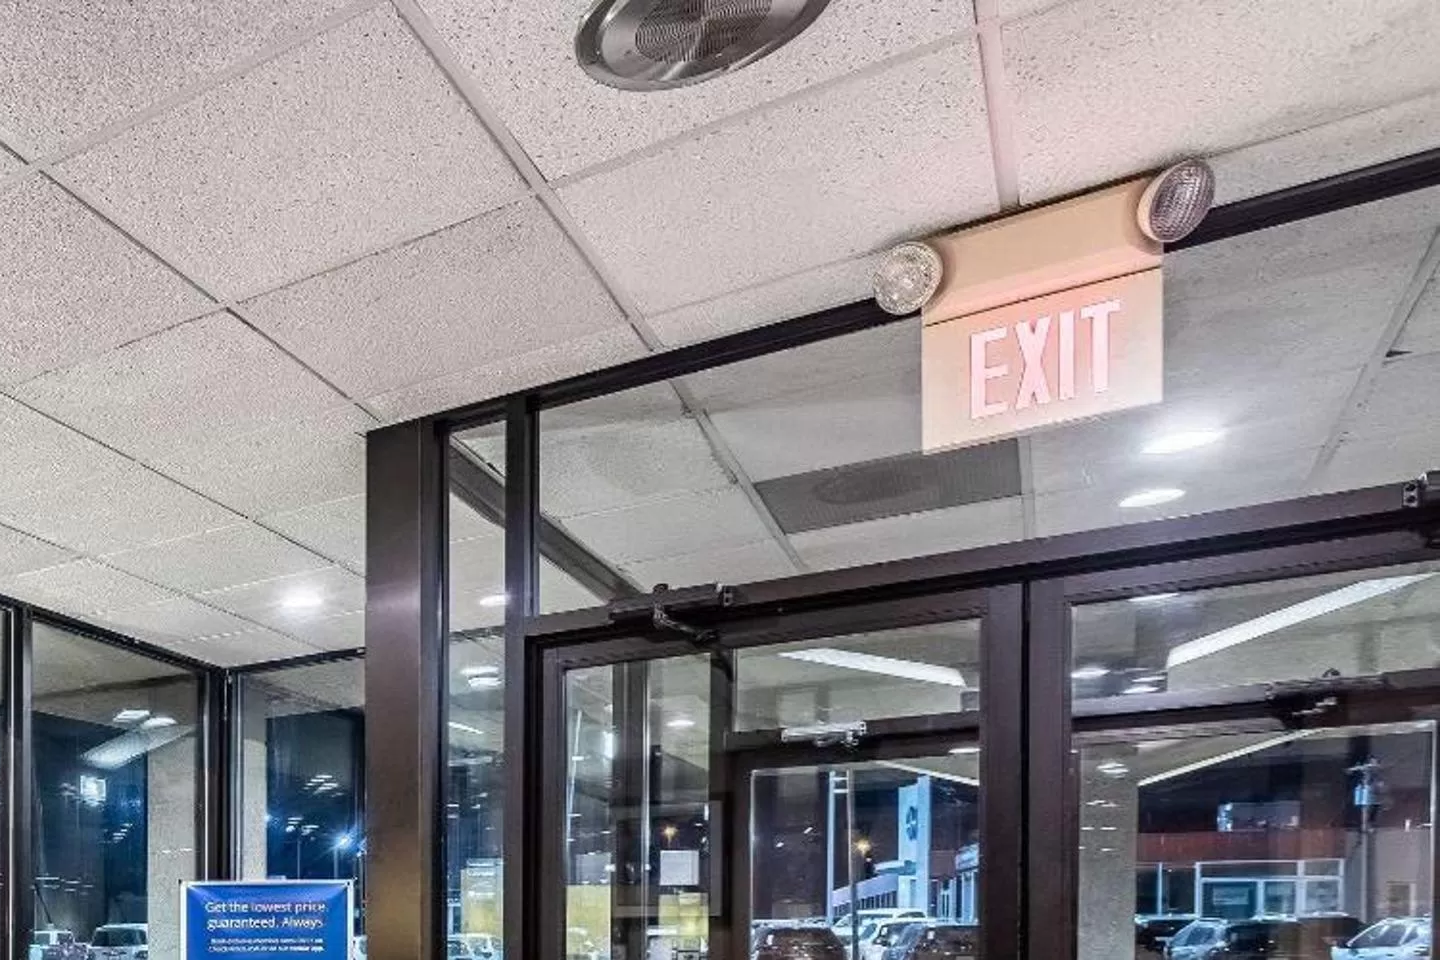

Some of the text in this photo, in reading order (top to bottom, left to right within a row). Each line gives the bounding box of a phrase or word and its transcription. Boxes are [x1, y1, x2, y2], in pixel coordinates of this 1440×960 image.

[970, 300, 1121, 419] EXIT
[205, 902, 226, 913] Get
[228, 902, 248, 913] the
[251, 902, 292, 913] lowest
[207, 917, 279, 931] guaranteed.
